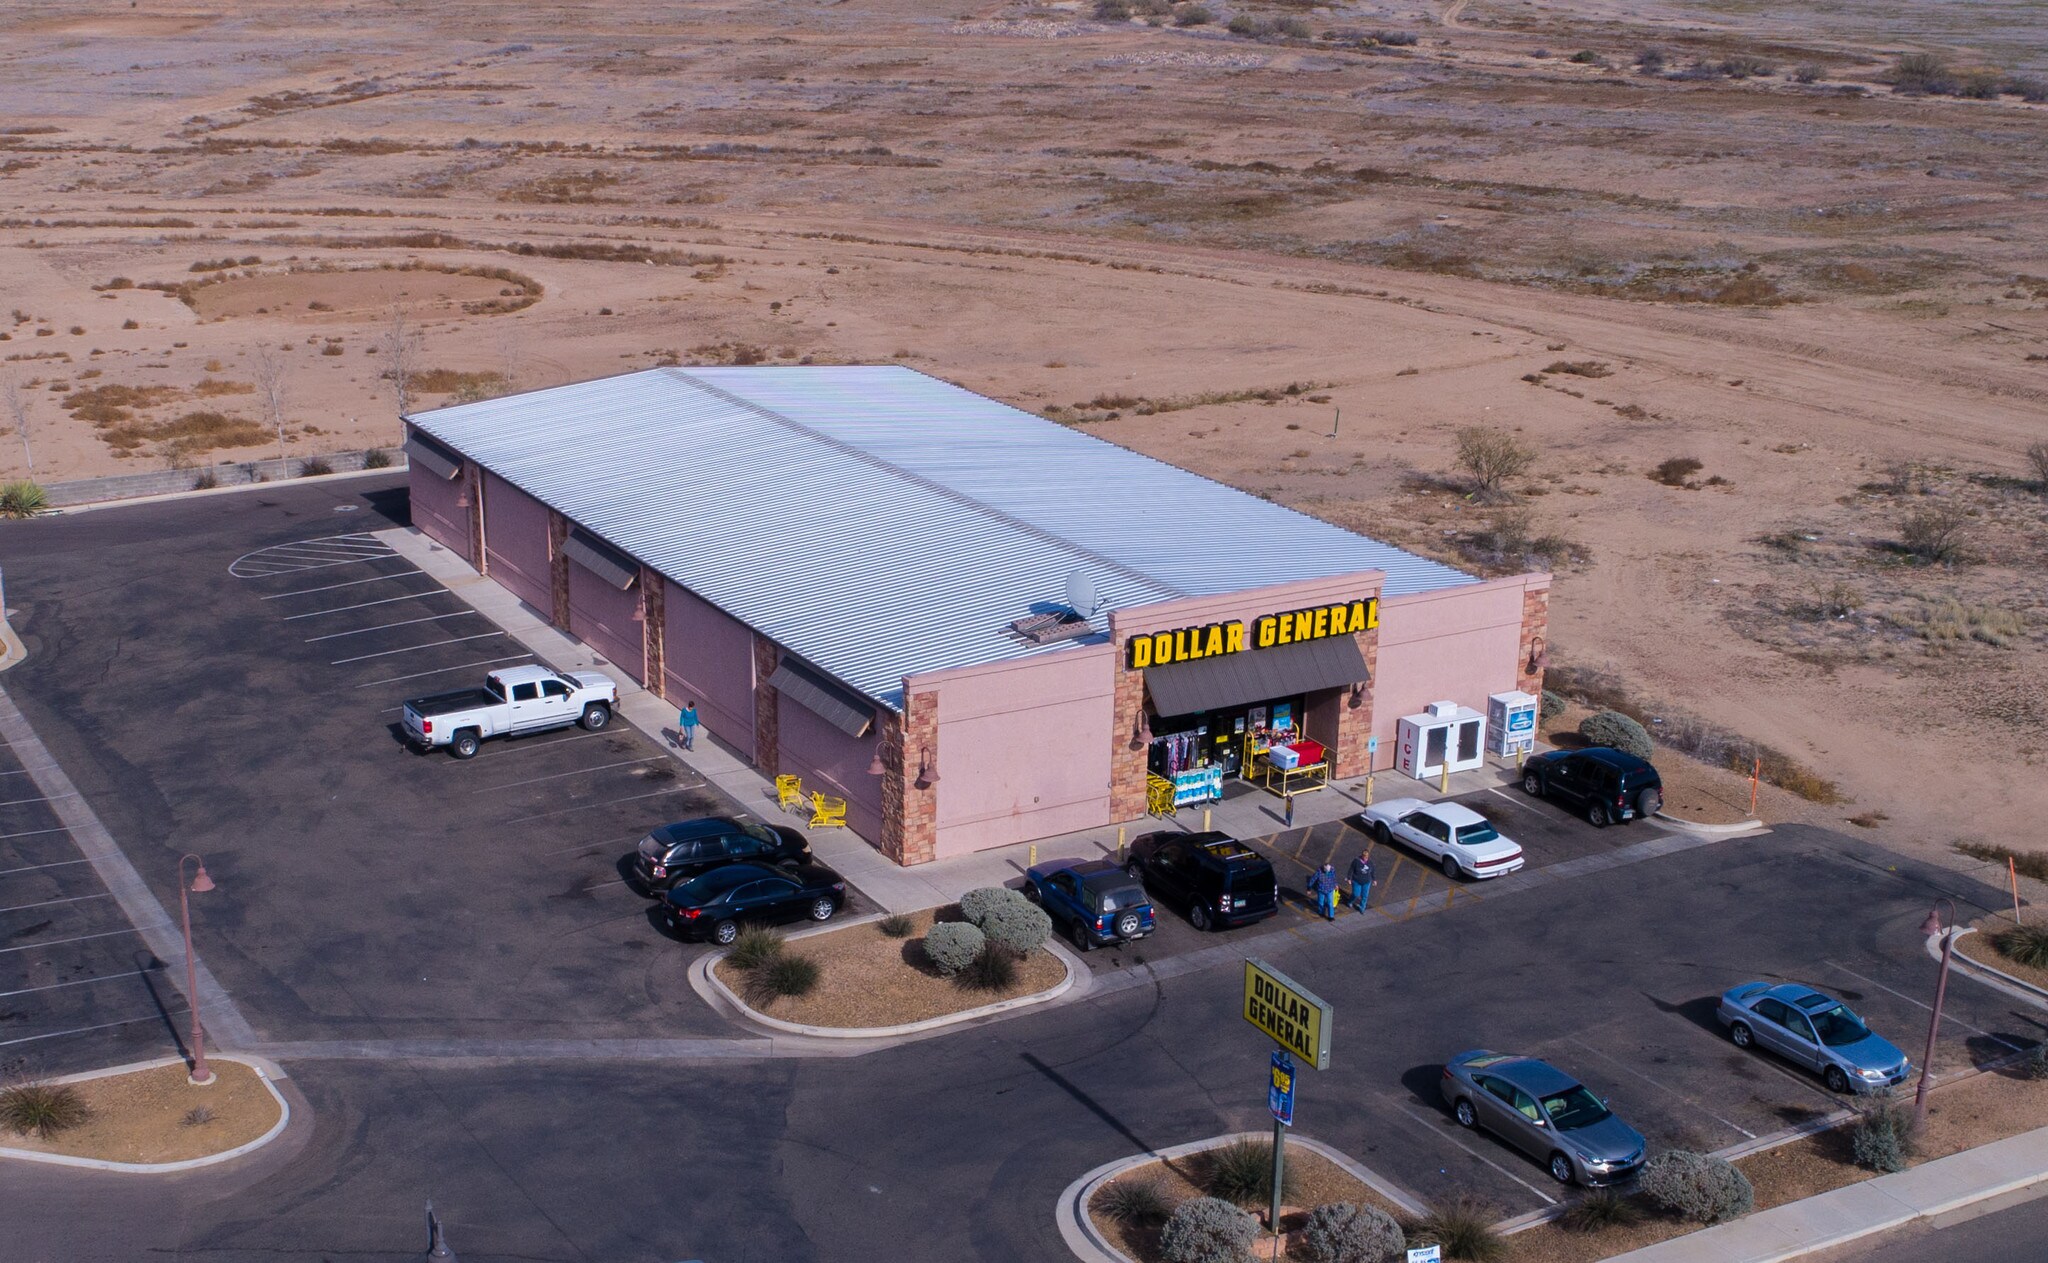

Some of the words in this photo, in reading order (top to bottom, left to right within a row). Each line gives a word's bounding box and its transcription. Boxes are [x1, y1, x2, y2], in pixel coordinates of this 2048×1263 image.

[1132, 620, 1244, 668] DOLLAR
[1258, 598, 1379, 647] GENERAL
[1403, 728, 1411, 771] ICE
[1249, 996, 1312, 1058] GENERAL
[1254, 973, 1309, 1030] DOLLAR
